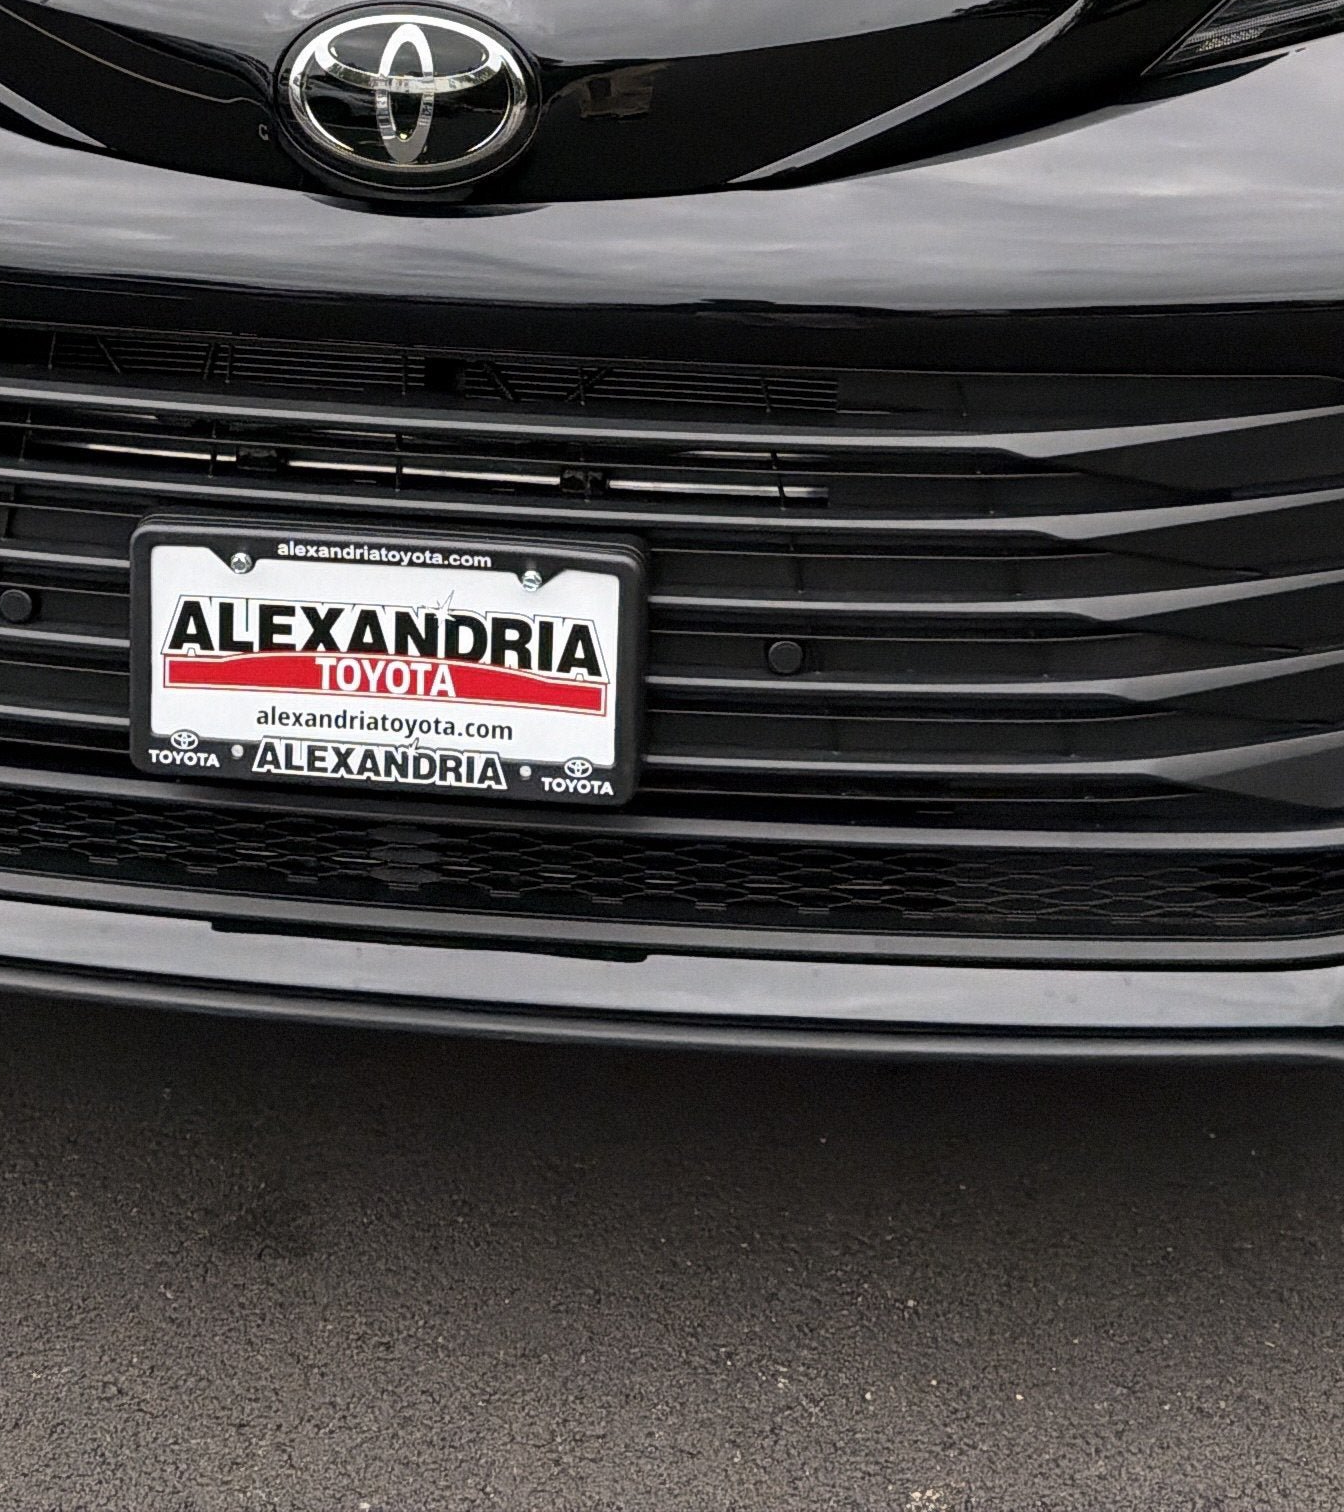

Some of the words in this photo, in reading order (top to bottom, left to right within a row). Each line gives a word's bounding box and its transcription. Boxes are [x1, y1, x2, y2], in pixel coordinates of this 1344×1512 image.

[277, 541, 492, 569] alexandriatoyota.com
[166, 597, 605, 680] ALEXANDRIA
[314, 656, 457, 698] TOYOTA
[255, 705, 514, 741] alexandriatoyota.com
[149, 749, 220, 769] TOYOTA
[252, 736, 507, 789] ALEXANDRIA
[541, 777, 614, 796] TOYOTA
